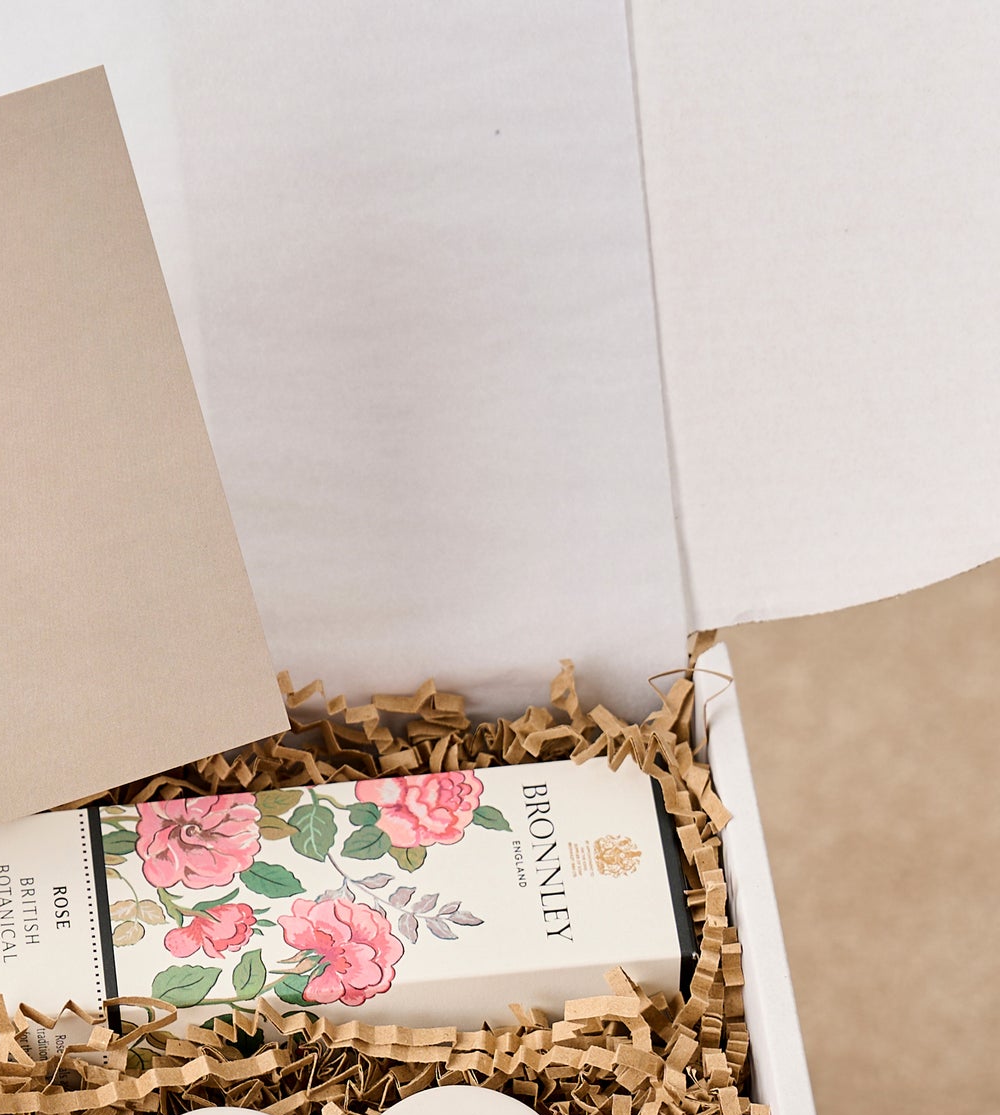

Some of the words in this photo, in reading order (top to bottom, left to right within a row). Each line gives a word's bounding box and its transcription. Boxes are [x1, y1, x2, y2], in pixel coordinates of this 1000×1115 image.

[512, 840, 527, 888] ENGLAND
[521, 781, 574, 943] BRONNLEY
[20, 877, 40, 945] BRITISH
[53, 885, 71, 930] ROSE
[37, 1028, 50, 1061] tradition
